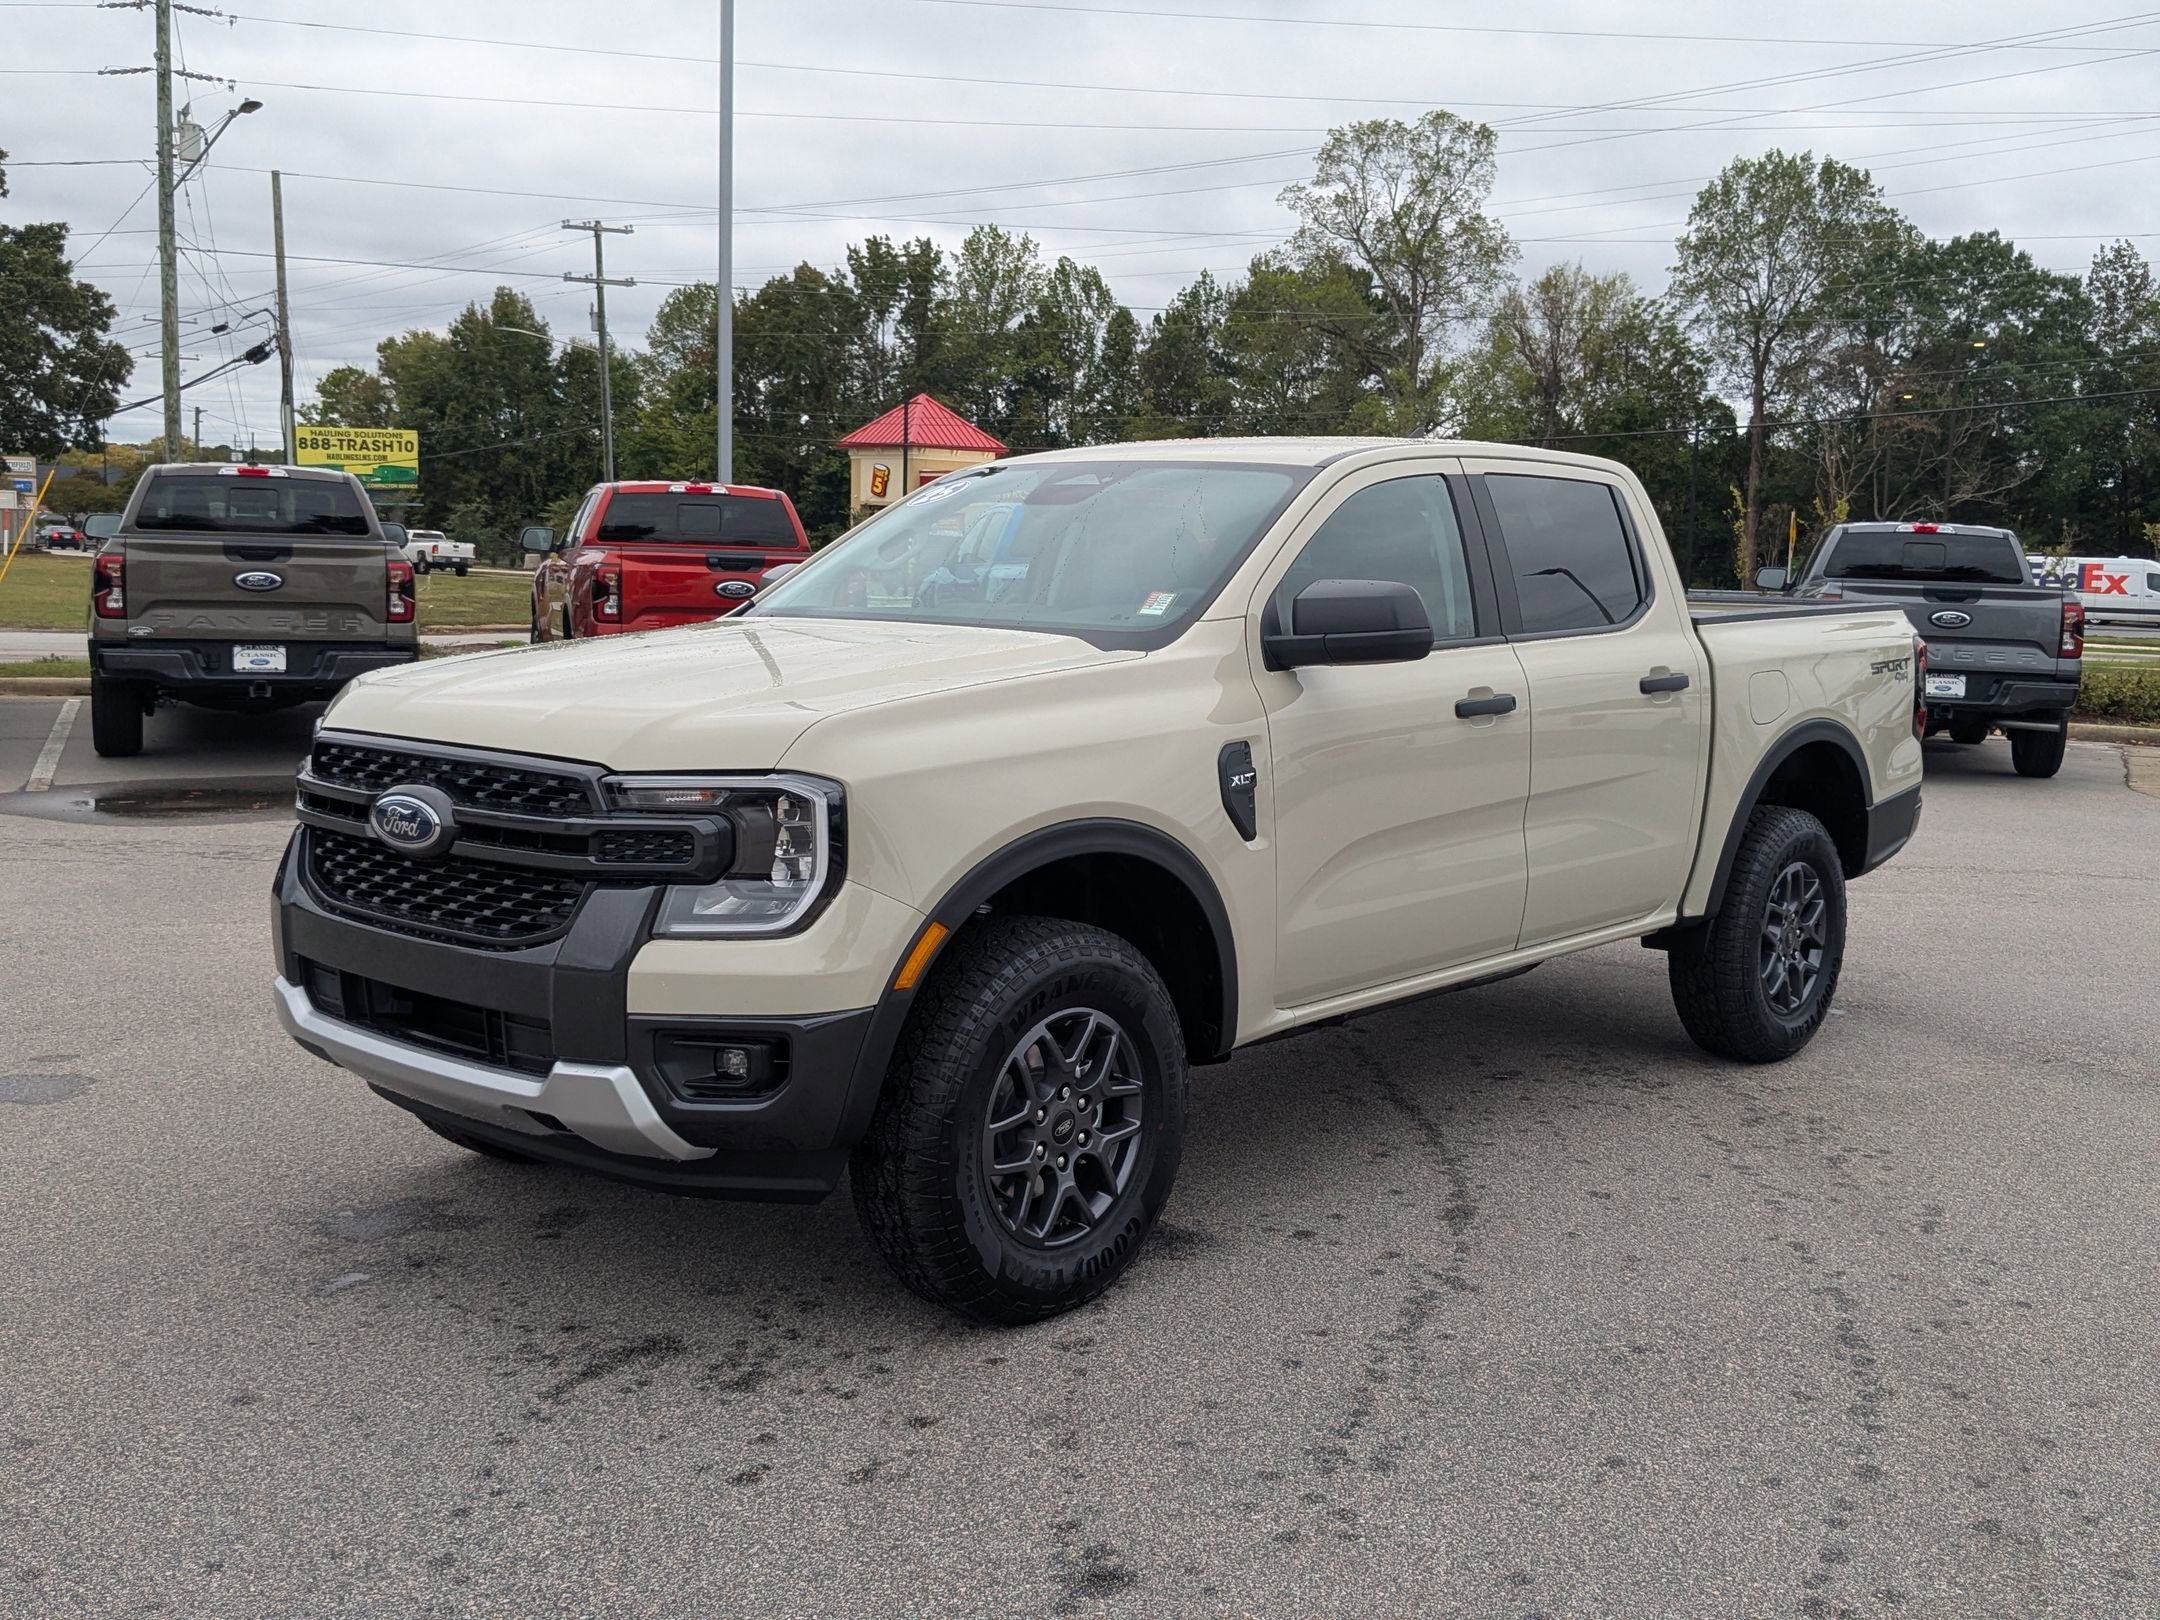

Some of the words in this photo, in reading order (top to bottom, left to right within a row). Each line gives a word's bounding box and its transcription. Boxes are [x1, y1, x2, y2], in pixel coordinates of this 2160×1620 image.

[310, 430, 351, 438] HAULING
[353, 431, 404, 439] SOLUTIONS
[326, 453, 388, 461] HAULINGSLNS.COM
[872, 477, 882, 494] 5
[151, 613, 365, 631] RANGER
[1926, 647, 2039, 665] NGER
[1870, 657, 1911, 675] SPORT
[1230, 772, 1255, 787] XLT
[383, 805, 421, 837] Ford
[1006, 1217, 1142, 1294] GOODYEAR
